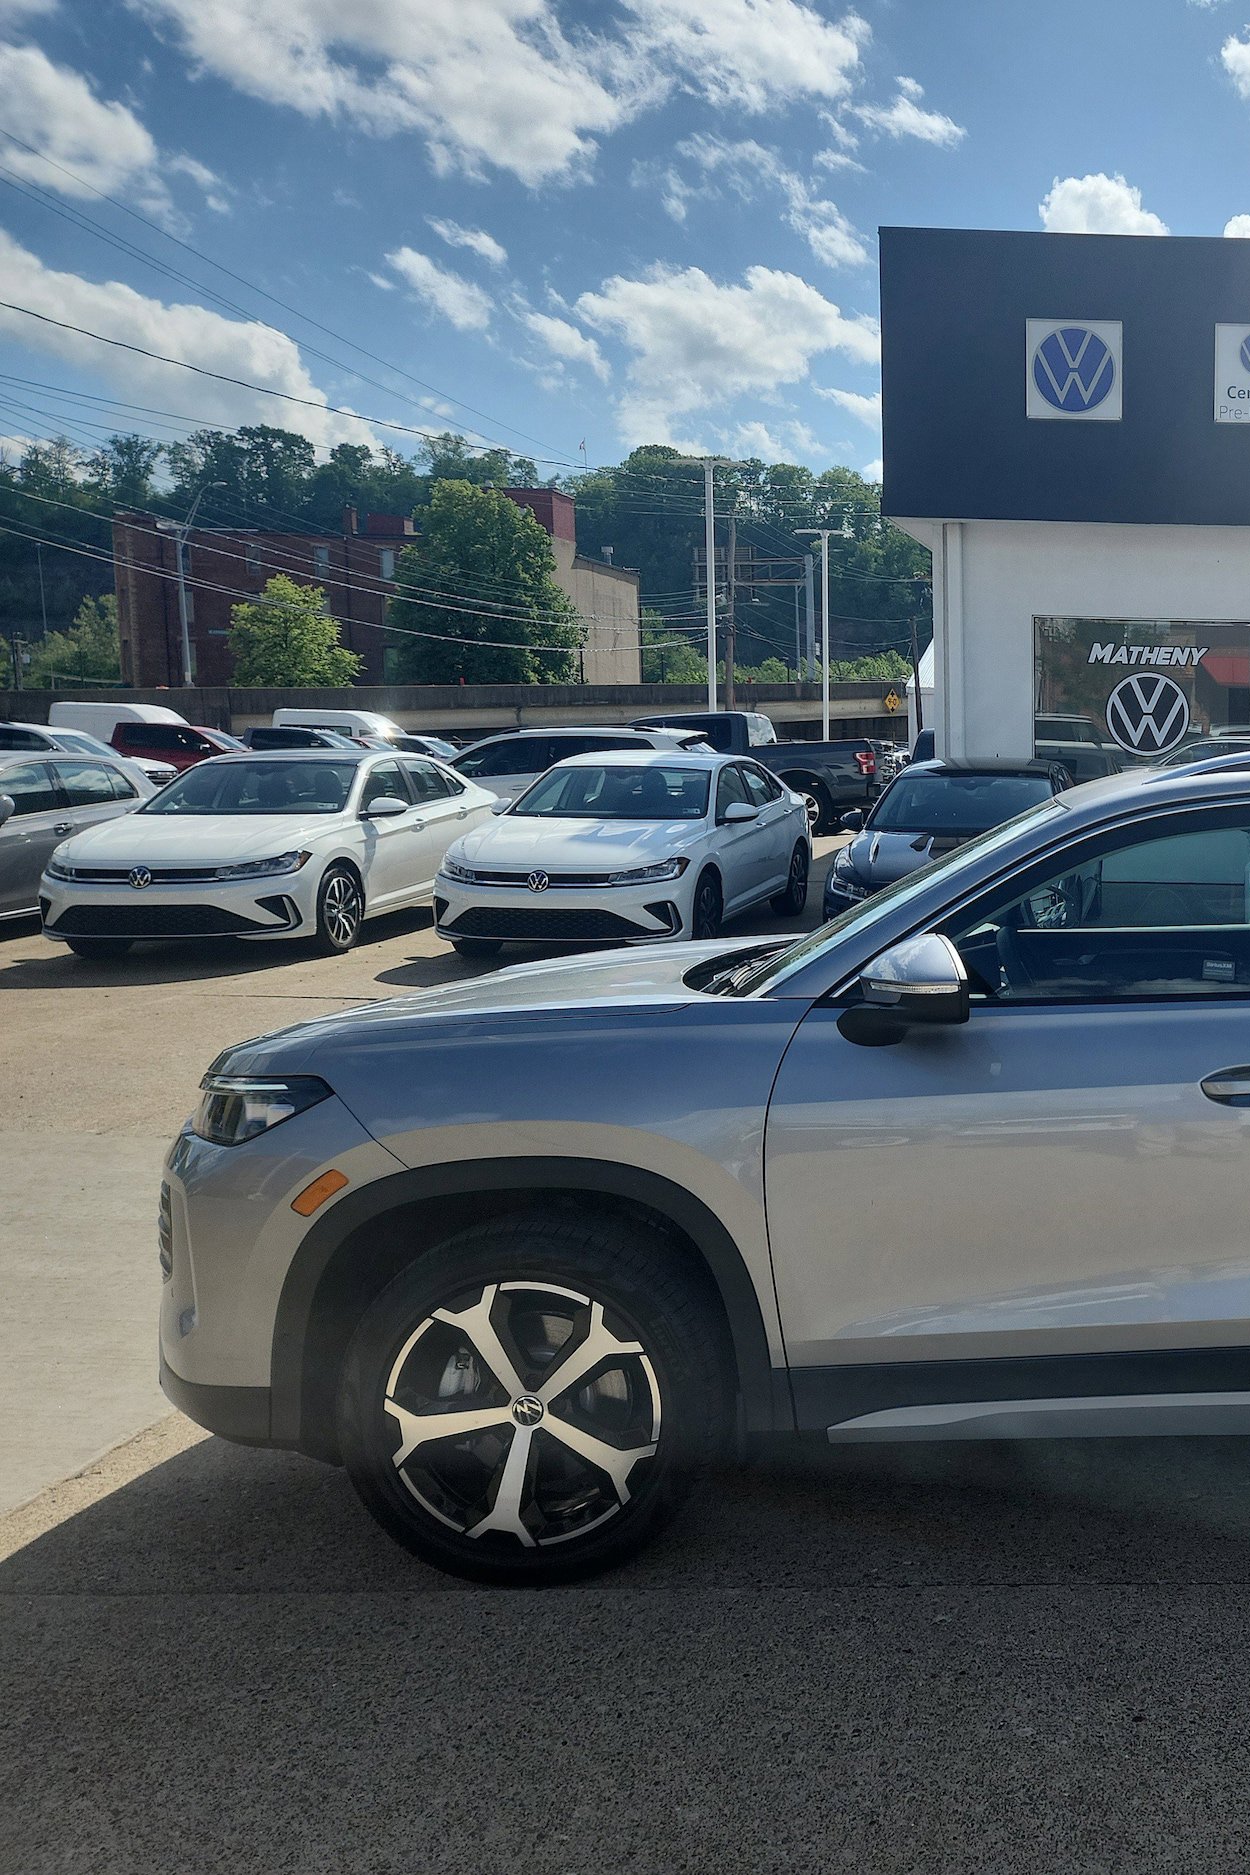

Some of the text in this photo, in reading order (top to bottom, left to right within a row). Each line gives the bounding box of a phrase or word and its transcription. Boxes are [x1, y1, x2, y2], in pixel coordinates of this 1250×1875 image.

[1033, 326, 1115, 412] VW
[1089, 643, 1208, 666] MATHENY
[1106, 672, 1189, 756] VW
[128, 865, 152, 889] VW
[526, 869, 549, 893] VW
